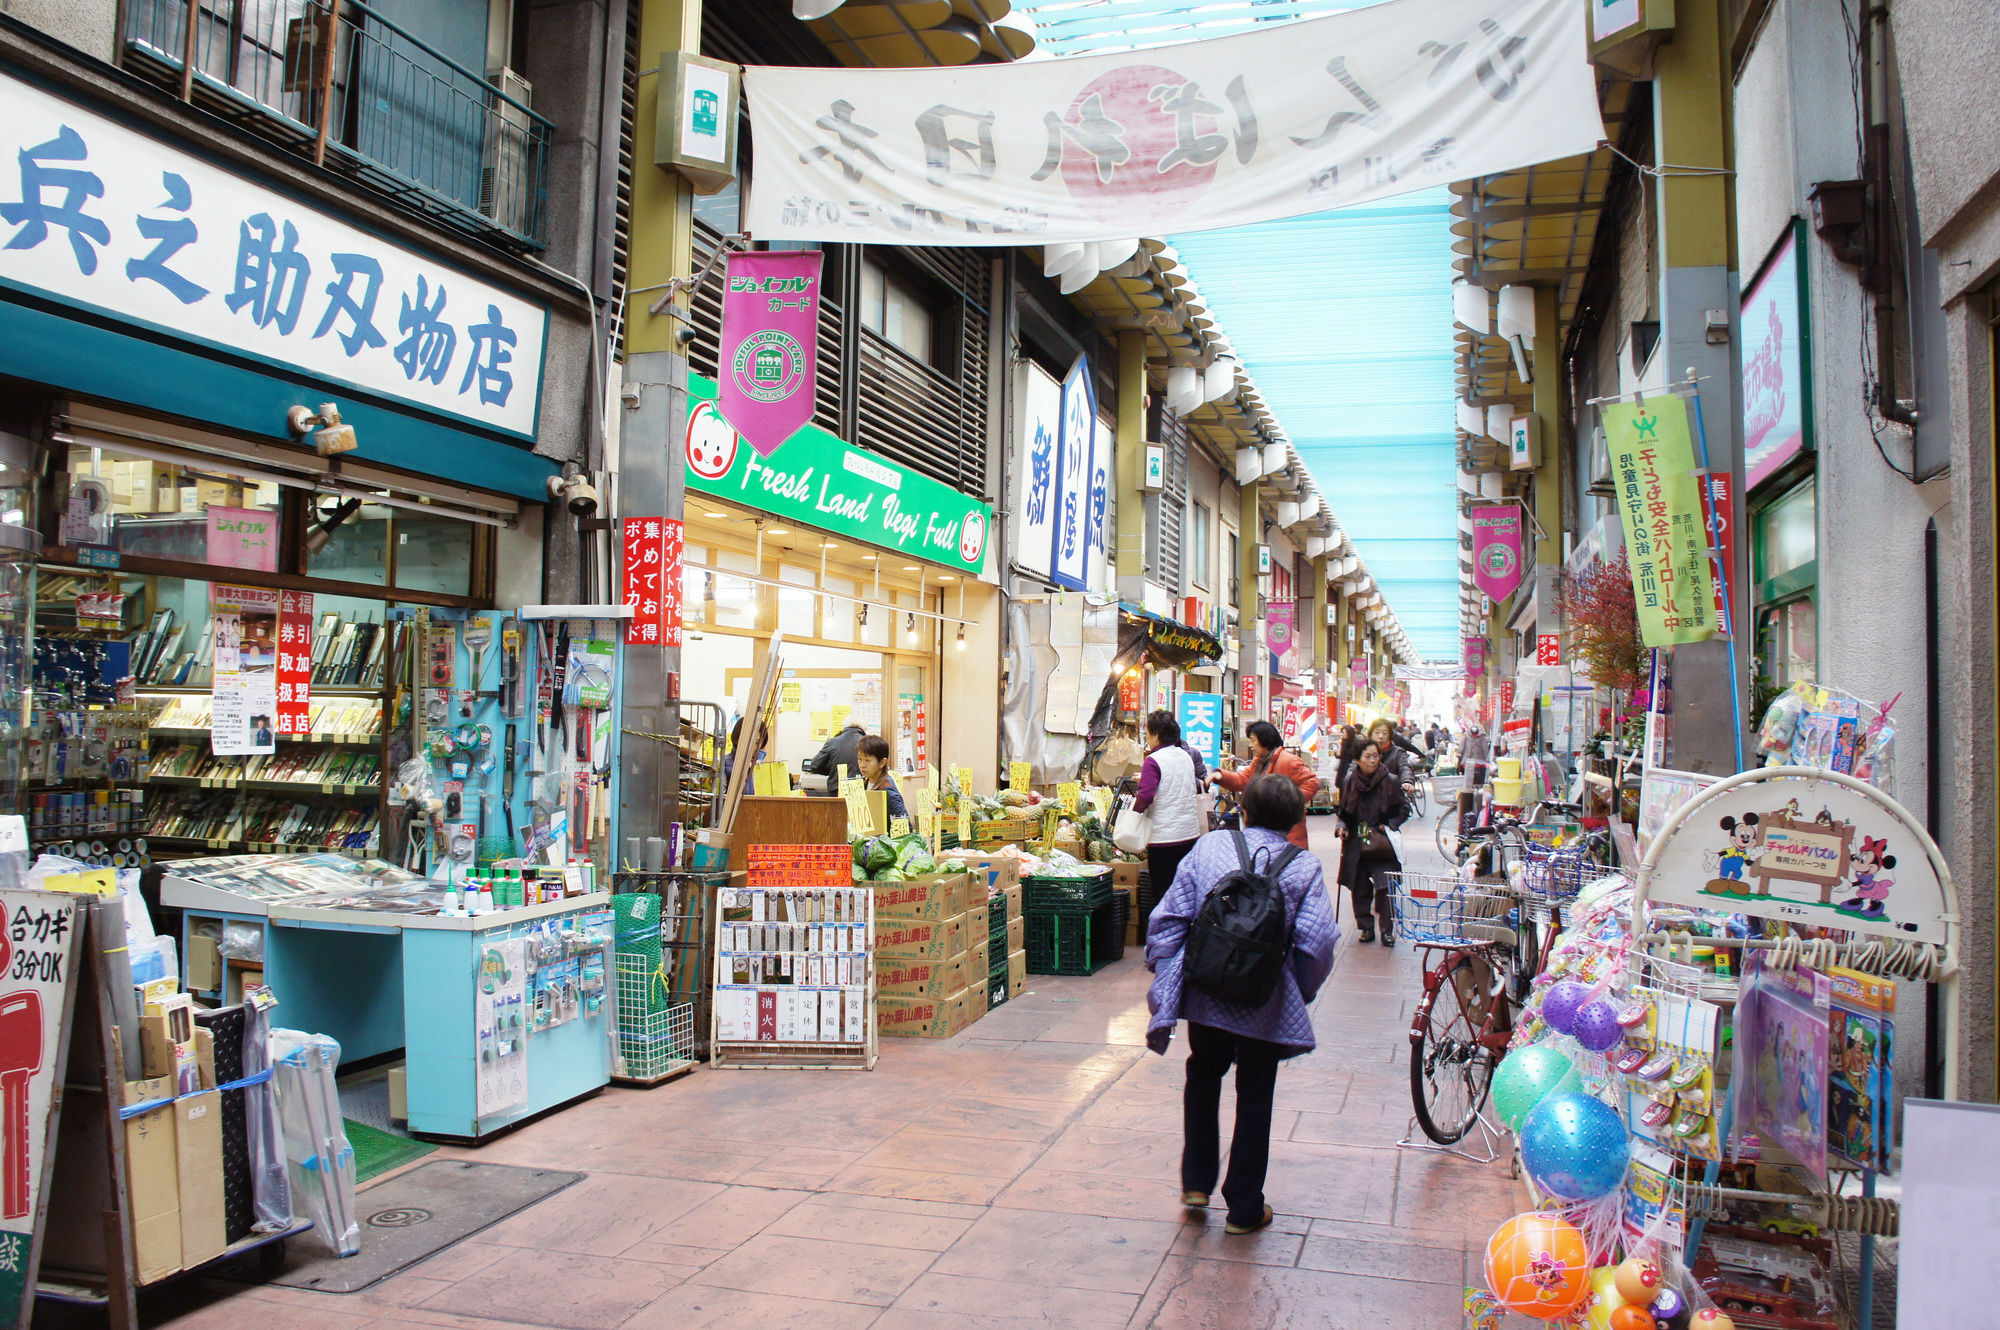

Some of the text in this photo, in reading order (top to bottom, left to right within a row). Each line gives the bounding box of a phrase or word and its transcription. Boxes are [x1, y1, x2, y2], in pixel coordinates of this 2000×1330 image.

[1, 124, 518, 407] 兵之助刃物店
[730, 276, 815, 293] ジョイフル
[768, 297, 811, 312] カード
[758, 332, 790, 347] POINT
[790, 341, 802, 375] CARD
[1060, 392, 1084, 560] 小川屋
[740, 451, 814, 501] Fresh
[816, 473, 869, 523] Land
[881, 493, 918, 545] Vegi
[925, 512, 958, 551] Full
[217, 518, 270, 534] ジョイフル
[241, 540, 268, 550] カード
[643, 521, 660, 641] 集めてお得
[665, 521, 674, 642] ポイントカード
[278, 592, 295, 732] 金券取扱店
[295, 594, 312, 732] 福引加盟店
[1766, 841, 1838, 860] チャイルドパズル
[1776, 856, 1827, 869] 専用カバーつき
[10, 905, 72, 944] 合カギ
[12, 949, 63, 983] 3分OK
[761, 997, 773, 1040] 消火栓
[849, 1000, 859, 1041] 営業中
